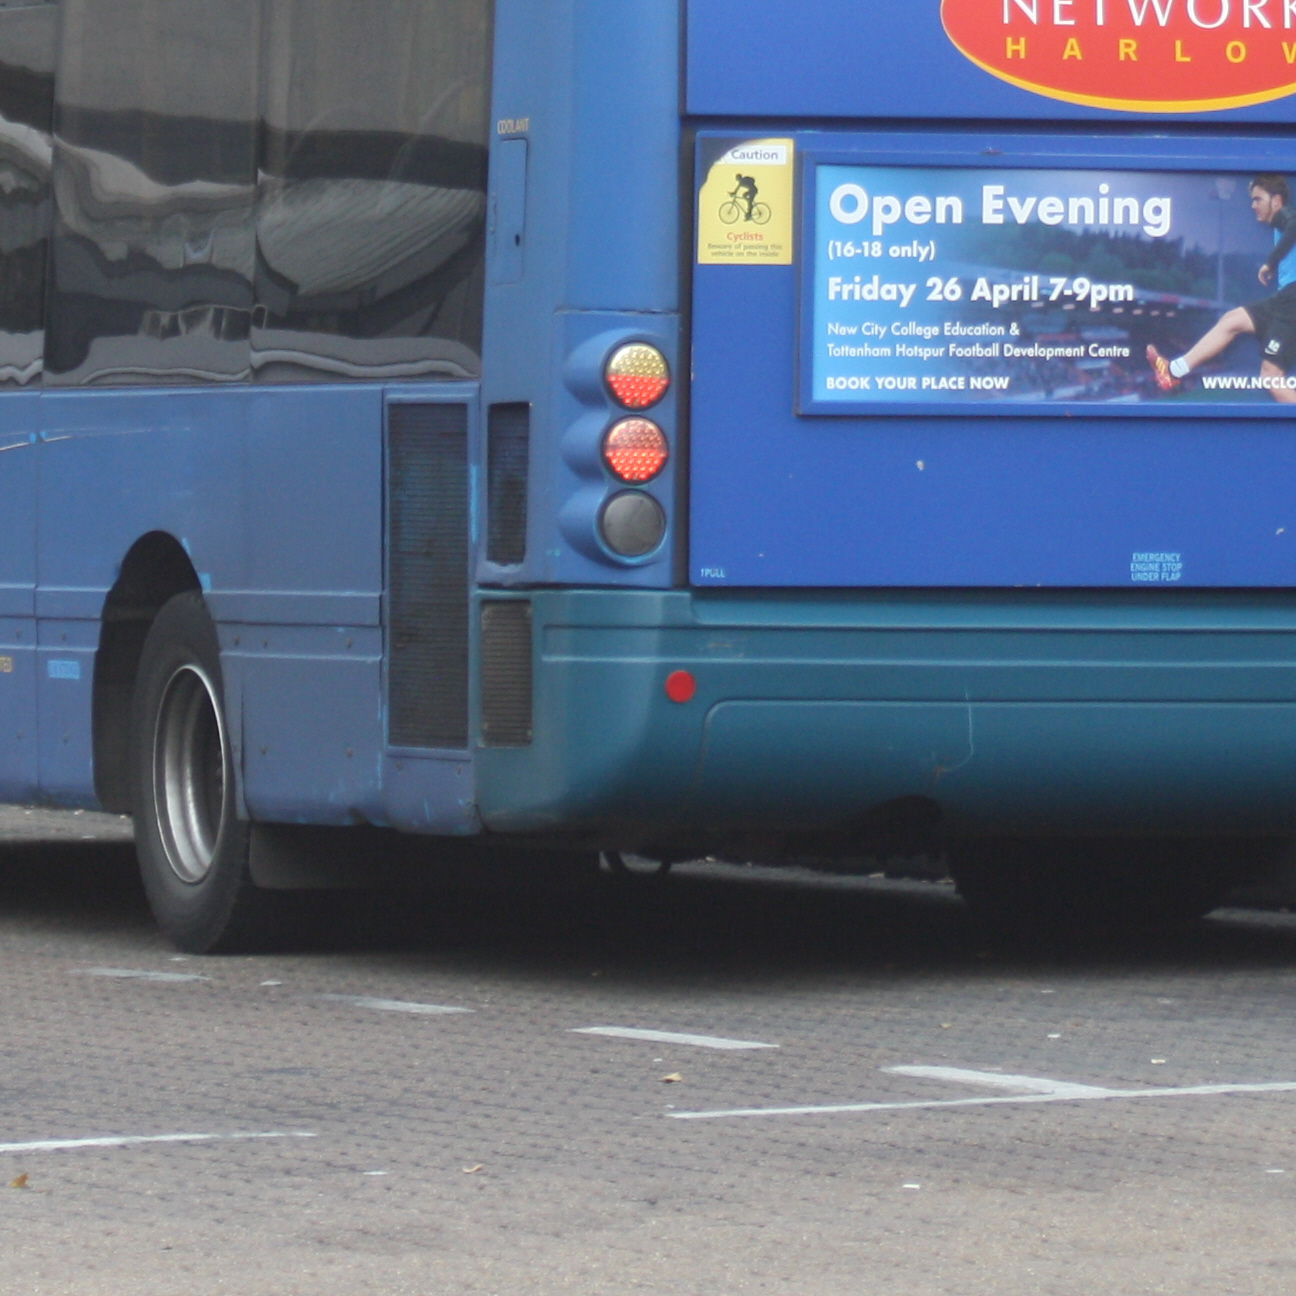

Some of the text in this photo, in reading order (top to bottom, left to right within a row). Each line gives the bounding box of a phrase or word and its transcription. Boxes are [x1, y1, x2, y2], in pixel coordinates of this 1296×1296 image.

[731, 149, 779, 160] Caution
[829, 183, 1171, 237] Open Evening
[726, 232, 764, 242] Cyclists
[828, 240, 935, 261] (16-18 only)
[827, 275, 1134, 308] Friday 26 April 7-9pm
[827, 321, 1020, 340] New City College Education &
[827, 343, 1130, 361] Tottenham Hotspur Football Development Centre
[826, 377, 1010, 390] BOOK YOUR PLACE NOW
[1132, 552, 1181, 562] EMERGENCY
[1130, 562, 1183, 572] ENGINE STOP
[1131, 572, 1181, 582] UNDER FLAP
